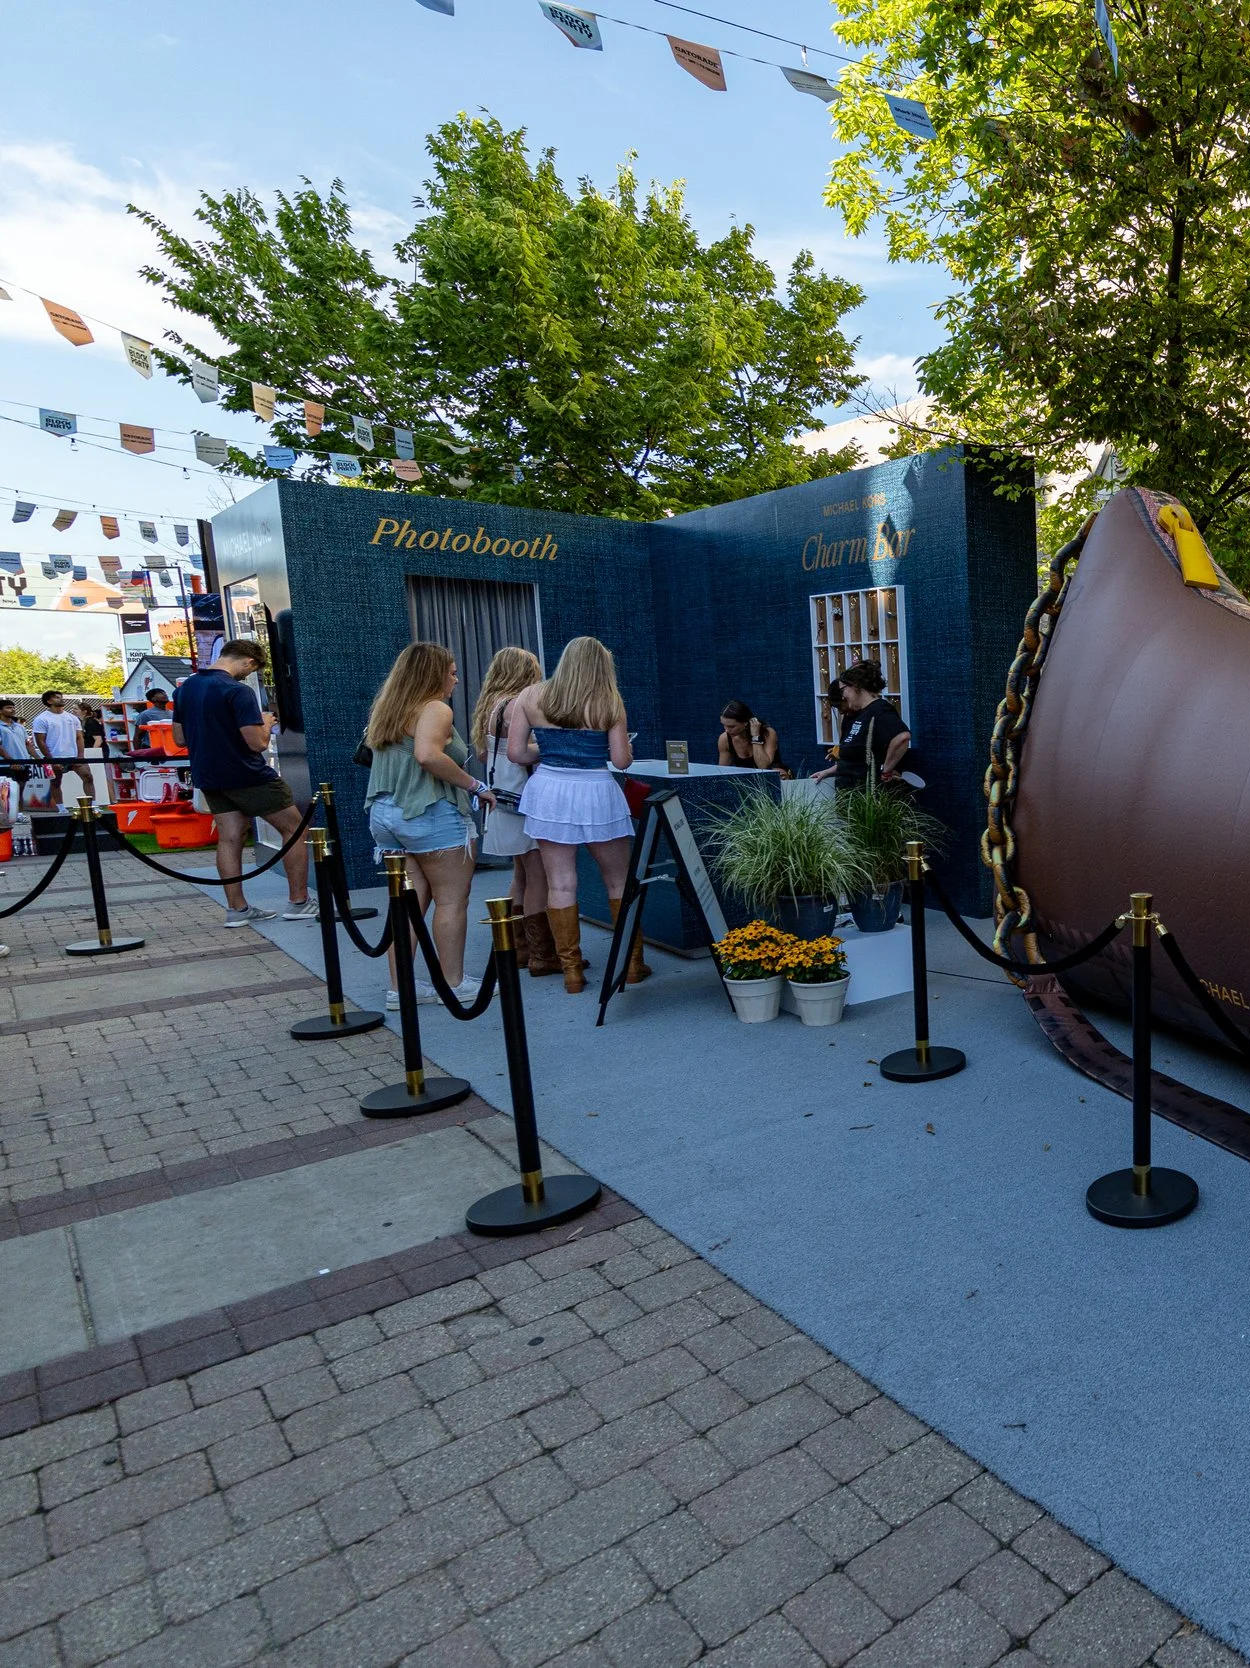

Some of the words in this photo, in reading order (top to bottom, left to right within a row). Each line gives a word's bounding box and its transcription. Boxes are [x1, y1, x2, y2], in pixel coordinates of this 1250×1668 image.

[674, 46, 720, 69] GATORADE
[128, 348, 149, 363] BLOCK
[130, 356, 150, 371] PARTY
[45, 417, 72, 425] BLOCK
[45, 422, 73, 430] PARTY
[822, 499, 860, 518] MICHAEL
[862, 491, 888, 510] KORS
[368, 517, 559, 561] Photobooth
[802, 531, 868, 572] Charm
[871, 522, 917, 562] Bar
